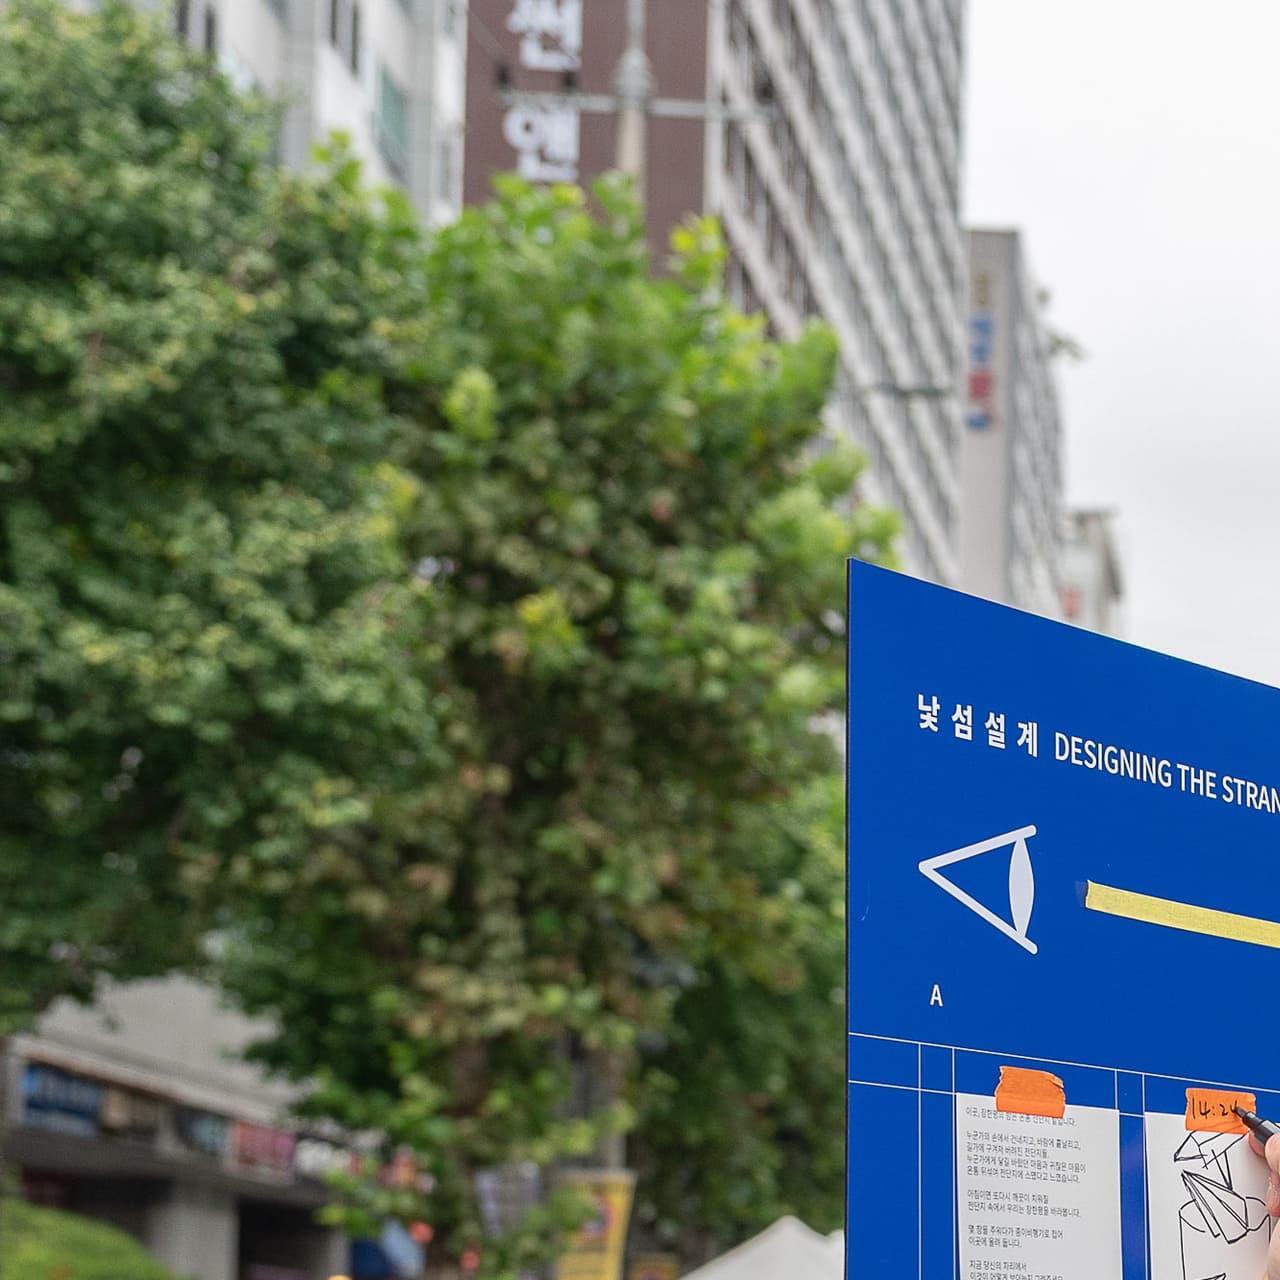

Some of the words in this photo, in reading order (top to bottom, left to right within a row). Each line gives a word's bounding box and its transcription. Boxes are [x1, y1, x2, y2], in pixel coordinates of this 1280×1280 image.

[1054, 731, 1172, 788] DESIGNING
[1177, 763, 1217, 800] THE
[929, 984, 944, 1007] A
